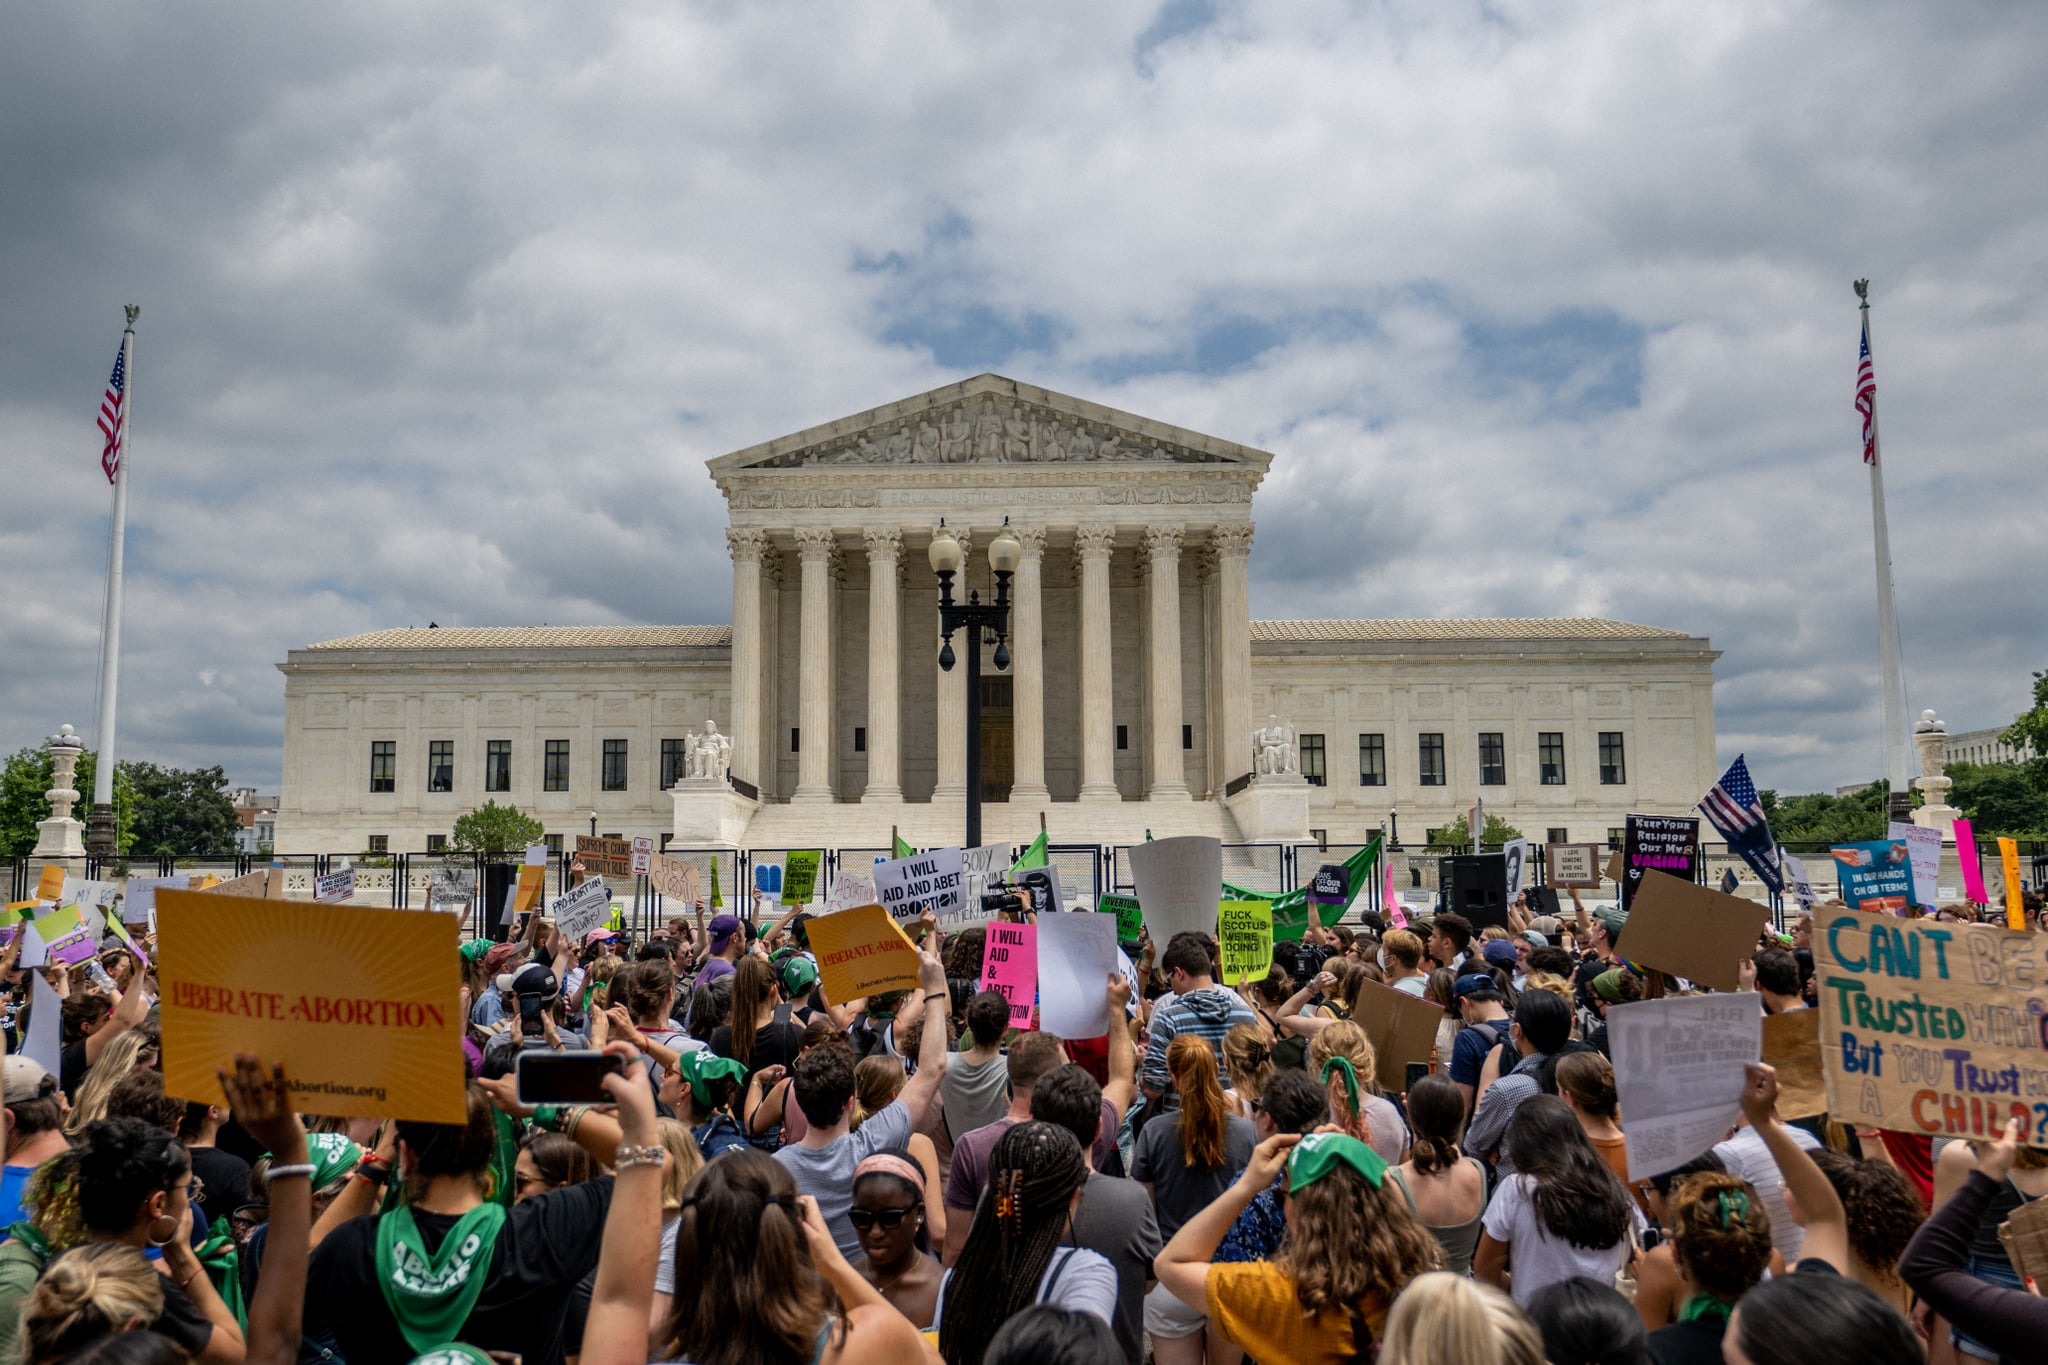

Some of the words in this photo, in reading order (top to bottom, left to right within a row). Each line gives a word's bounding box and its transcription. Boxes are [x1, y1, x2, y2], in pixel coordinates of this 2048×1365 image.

[890, 492, 940, 505] EQUAL
[941, 492, 999, 504] JUSTICE
[1007, 491, 1051, 503] UNDER
[578, 839, 609, 854] SUPREME
[610, 842, 629, 856] COURT
[634, 847, 651, 855] PARKING
[612, 861, 628, 875] RULE
[961, 848, 993, 874] BODY
[1631, 853, 1689, 869] VAGINA
[661, 856, 689, 883] HEX
[902, 866, 908, 880] I
[910, 859, 939, 878] WILL
[1316, 872, 1332, 880] BANS
[1852, 874, 1862, 883] IN
[1863, 872, 1877, 881] OUR
[1877, 869, 1905, 880] HANDS
[835, 876, 875, 904] ABORTION
[883, 886, 904, 903] AID
[907, 879, 931, 898] AND
[934, 871, 961, 892] ABET
[1316, 885, 1339, 894] BODIES
[1326, 879, 1341, 887] OUR
[1853, 887, 1866, 896] ON
[1867, 885, 1879, 894] OUR
[1880, 882, 1909, 892] TERMS
[552, 877, 602, 913] PRO-ABORTION
[1104, 896, 1141, 910] OVERTURN
[892, 890, 958, 919] ABORTION
[1224, 910, 1252, 919] FUCK
[1224, 921, 1267, 930] SCOTUS
[991, 929, 996, 943] I
[999, 929, 1024, 946] WILL
[1225, 932, 1258, 941] WE'RE
[822, 943, 876, 967] LIBERATE
[989, 946, 1009, 962] AID
[1225, 943, 1258, 952] DOING
[1828, 916, 1953, 980] CAN'T
[1967, 931, 2036, 992] BE
[1226, 954, 1235, 962] IT
[987, 964, 997, 980] &
[1226, 964, 1266, 973] ANYWAY
[171, 981, 285, 1021] LIBERATE
[289, 995, 445, 1030] ABORTION
[1964, 1003, 2039, 1048] WITH
[1891, 1043, 1944, 1087] YOU
[1860, 1078, 1883, 1117] A
